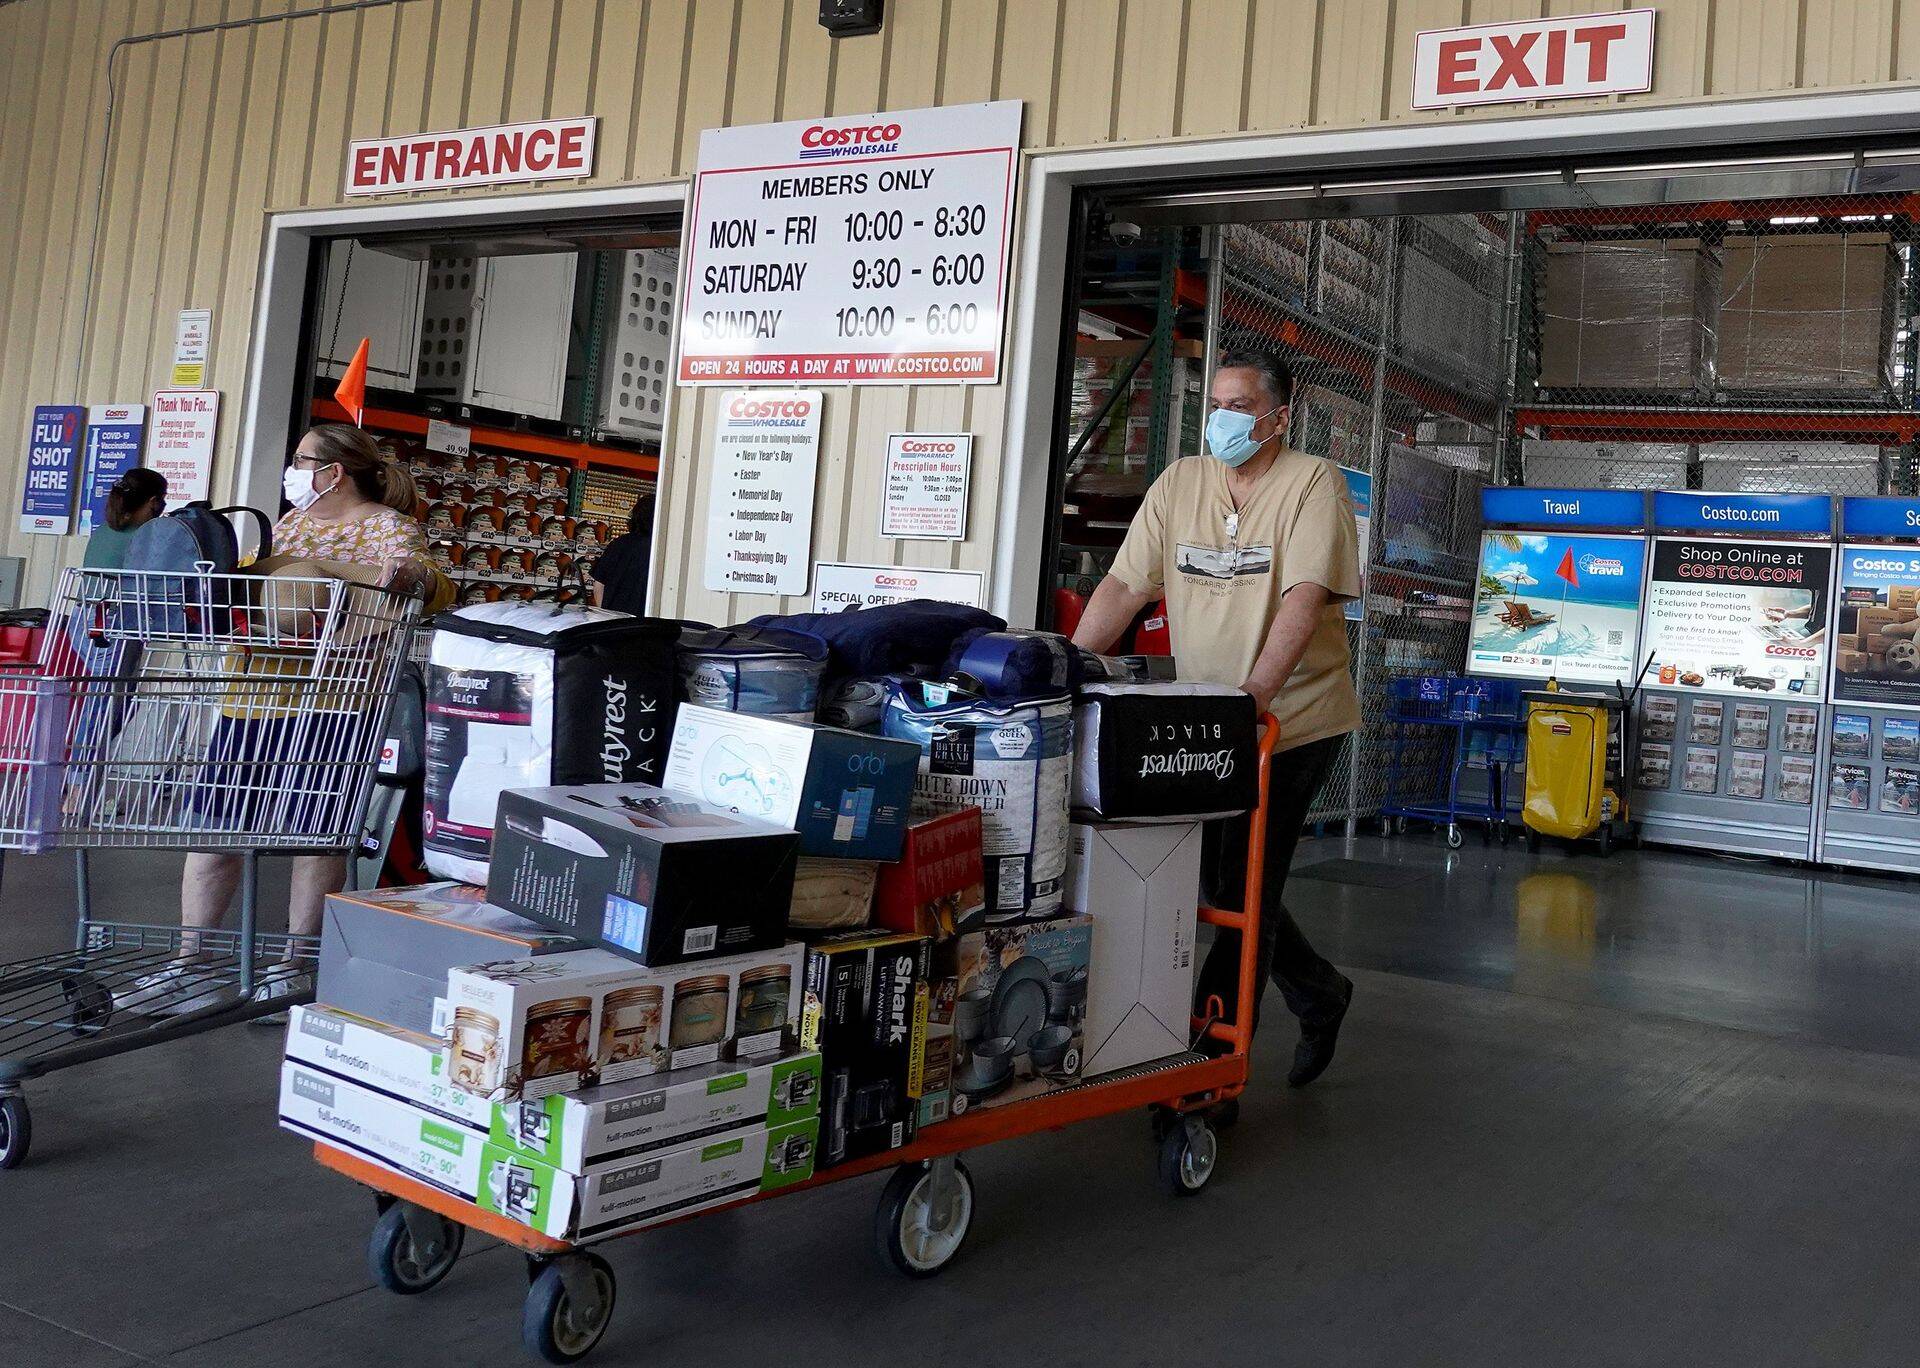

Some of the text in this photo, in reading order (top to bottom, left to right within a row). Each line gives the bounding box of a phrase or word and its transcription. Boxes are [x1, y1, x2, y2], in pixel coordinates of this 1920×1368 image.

[1437, 25, 1626, 95] EXIT
[353, 127, 586, 186] ENTRANCE
[831, 143, 898, 157] WHOLESALE
[762, 169, 934, 199] MEMBERS ONLY
[710, 205, 986, 249] MON FRI 10:00 8:30
[703, 253, 985, 295] SATURDAY 9:30 6:00
[702, 303, 978, 340] SUNDAY 10:00 6:00
[690, 357, 983, 375] OPEN 24 HOURS A DAY AT WWW.COSTCO.COM
[157, 398, 178, 412] Thank
[181, 398, 192, 412] You
[184, 420, 196, 429] your
[752, 419, 806, 427] WHOLESALE
[35, 425, 62, 442] FLU
[160, 430, 205, 439] children with you
[739, 434, 753, 443] closed
[770, 435, 790, 444] following
[101, 442, 137, 450] Vaccinations
[445, 444, 468, 455] 49.99
[32, 448, 71, 466] SHOT
[99, 452, 126, 460] Available
[742, 450, 793, 463] New Year's Day
[99, 462, 117, 470] Today!
[179, 461, 195, 469] shoes
[893, 462, 961, 472] Prescription Hours
[29, 470, 67, 489] HERE
[166, 471, 197, 479] shirts while
[740, 470, 760, 479] Easter
[889, 484, 908, 492] Saturday
[739, 489, 782, 502] Memorial Day
[1543, 500, 1580, 515] Travel
[1701, 505, 1780, 523] Costco.com
[737, 510, 793, 523] Independence Day
[735, 530, 766, 543] Labor Day
[734, 550, 787, 565] Thanksgiving Day
[1681, 547, 1803, 565] Shop Online at
[1588, 564, 1623, 576] travel
[1853, 558, 1906, 571] Costco
[732, 571, 777, 585] Christmas Day
[1678, 563, 1803, 583] COSTCO.COM
[1183, 577, 1226, 590] TONGARIRO
[821, 592, 863, 604] SPECIAL
[1659, 588, 1746, 599] Expanded Selection
[1658, 599, 1751, 611] Exclusive Promotions
[1657, 610, 1692, 621] Delivery
[1659, 633, 1675, 641] Sign
[1691, 626, 1705, 634] first
[447, 671, 490, 691] Beautyrest
[453, 693, 480, 705] BLACK
[601, 674, 630, 783] utyrest
[1150, 724, 1221, 741] BLACK
[637, 699, 656, 773] ACK
[1138, 748, 1235, 780] Beautyrest
[1836, 766, 1865, 775] Services
[1888, 769, 1917, 780] Services
[915, 774, 1007, 796] HITE DOWN
[838, 971, 848, 981] 5
[889, 956, 913, 1043] Shark
[305, 1014, 342, 1033] SANUS
[912, 1025, 921, 1060] CLEANS
[324, 1045, 369, 1072] full-motion
[296, 1076, 331, 1096] SANUS
[610, 1094, 663, 1113] SANUS
[317, 1107, 361, 1134] full-motion
[606, 1125, 652, 1144] full-motion
[605, 1164, 658, 1185] SANUS
[600, 1195, 646, 1214] full-motion
